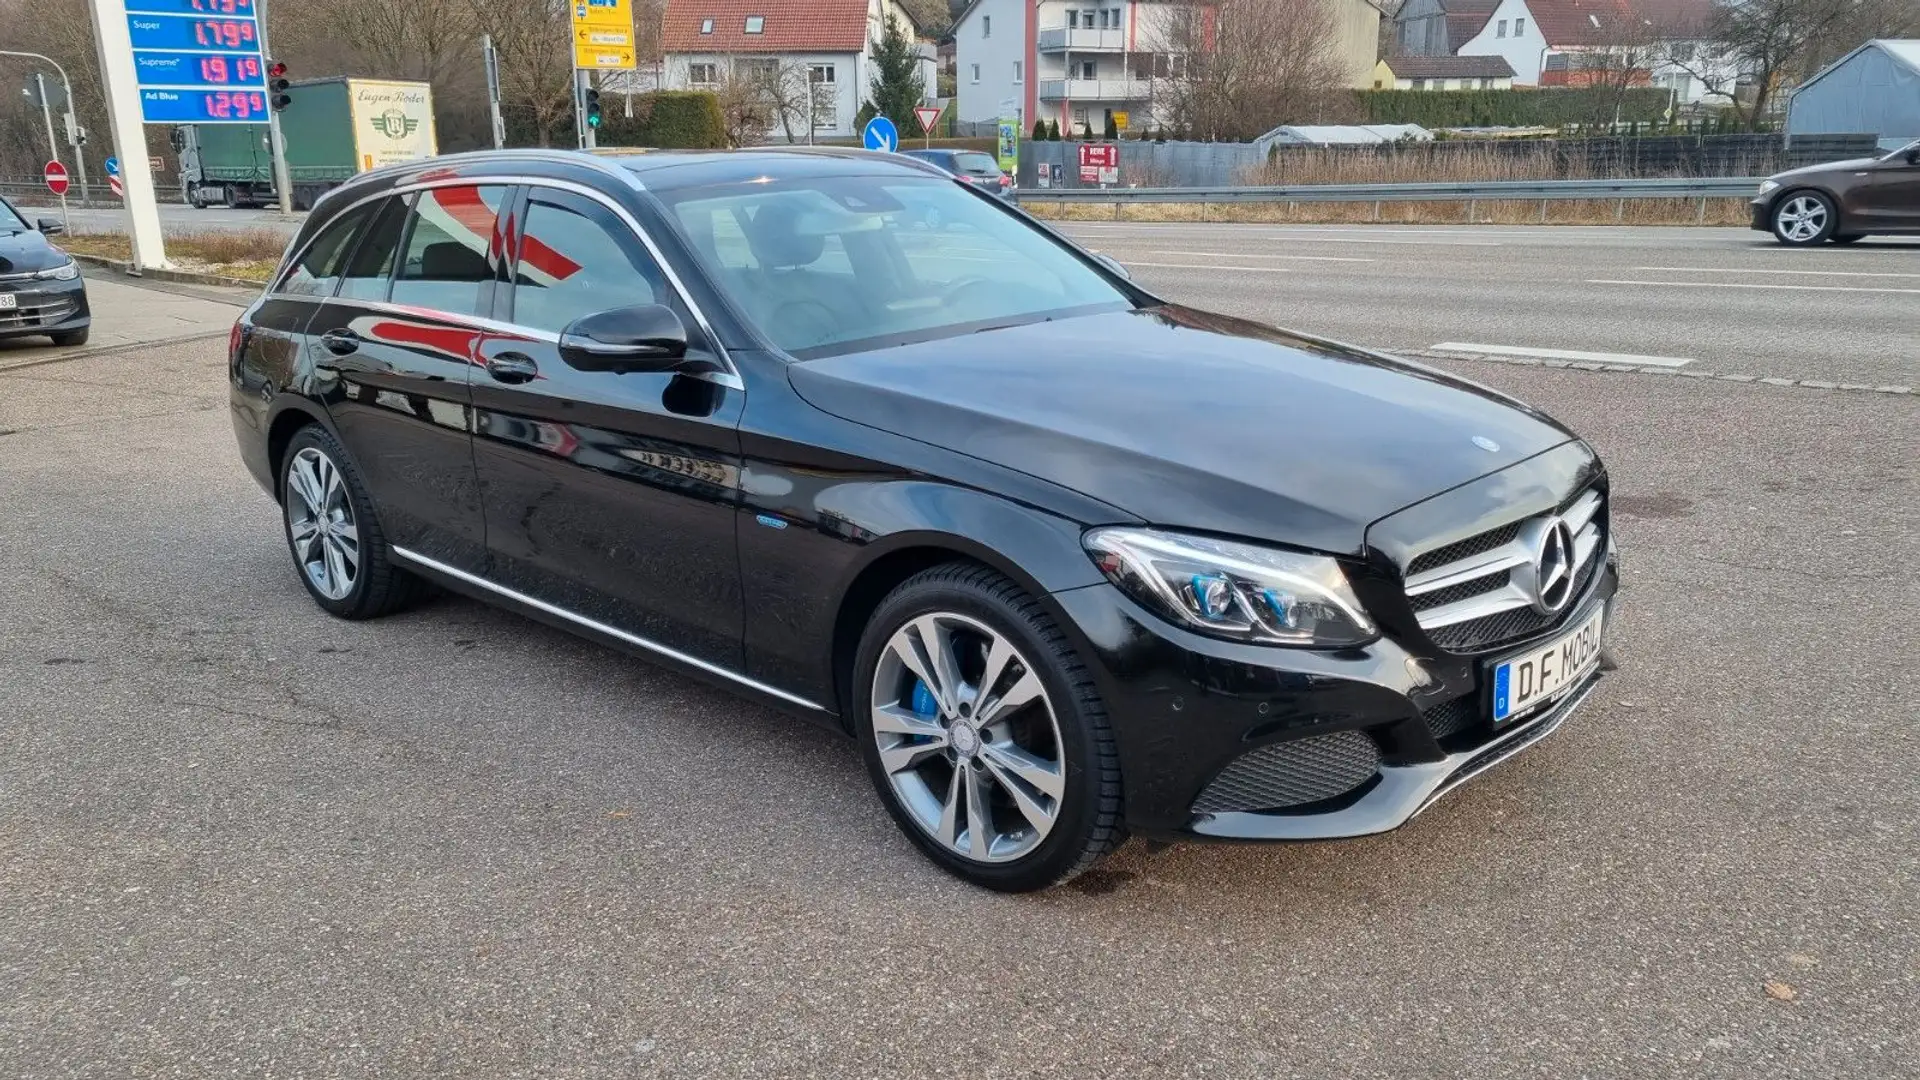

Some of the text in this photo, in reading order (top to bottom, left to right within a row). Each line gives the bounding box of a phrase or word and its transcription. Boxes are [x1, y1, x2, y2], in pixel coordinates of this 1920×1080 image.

[133, 20, 160, 31] Super
[145, 92, 179, 101] Ad Blue
[358, 88, 391, 105] Eugen
[1089, 147, 1105, 155] REWE
[1498, 697, 1505, 709] D
